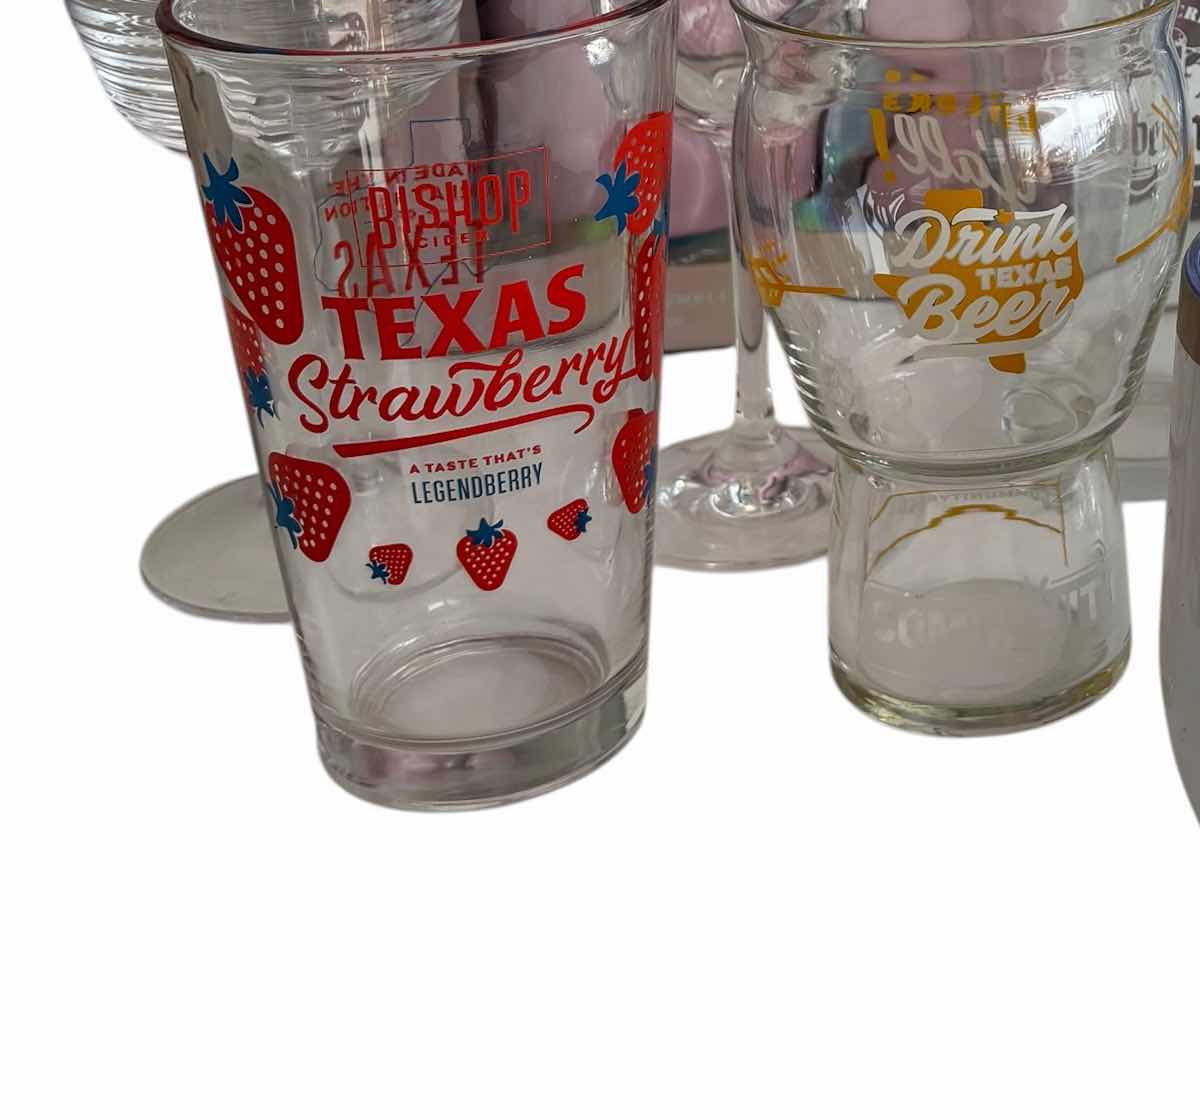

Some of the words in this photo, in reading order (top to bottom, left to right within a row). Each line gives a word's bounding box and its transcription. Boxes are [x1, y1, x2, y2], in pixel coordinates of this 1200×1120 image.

[367, 168, 530, 250] BISHOP
[894, 203, 1078, 269] Drink
[975, 256, 1073, 290] TEXAS
[320, 263, 587, 361] TEXAS
[897, 273, 1075, 346] Beer
[288, 326, 638, 434] Strawberry
[409, 463, 421, 475] A
[424, 456, 478, 474] TASTE
[482, 444, 542, 466] THAT'S
[411, 462, 543, 504] LEGENDBERRY
